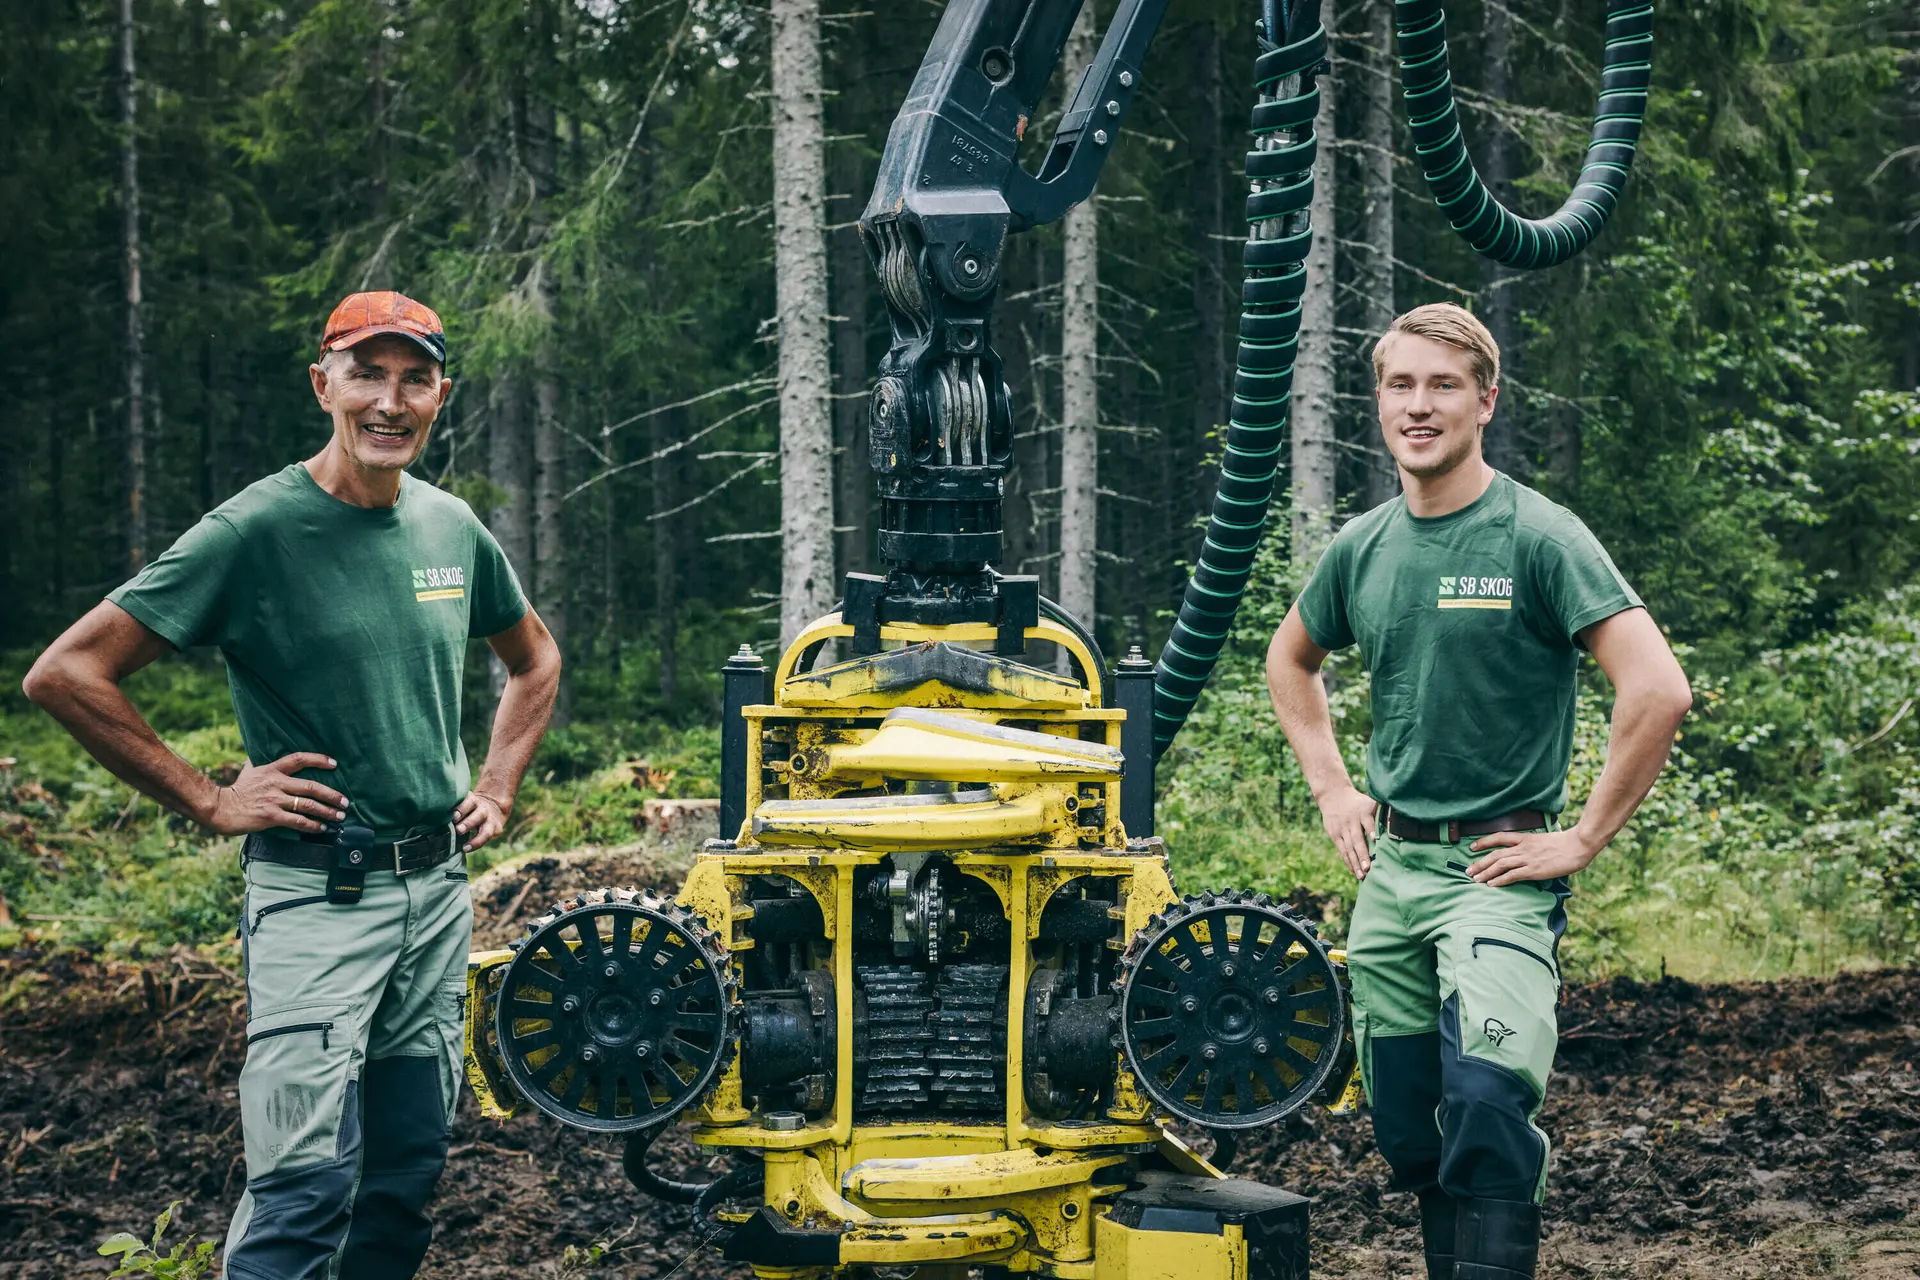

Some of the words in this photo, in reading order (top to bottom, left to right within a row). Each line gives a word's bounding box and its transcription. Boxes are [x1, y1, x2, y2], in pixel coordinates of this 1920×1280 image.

[426, 568, 440, 587] SB
[439, 566, 464, 586] SKOG
[1458, 576, 1476, 595] SB
[1478, 577, 1513, 597] SKOG
